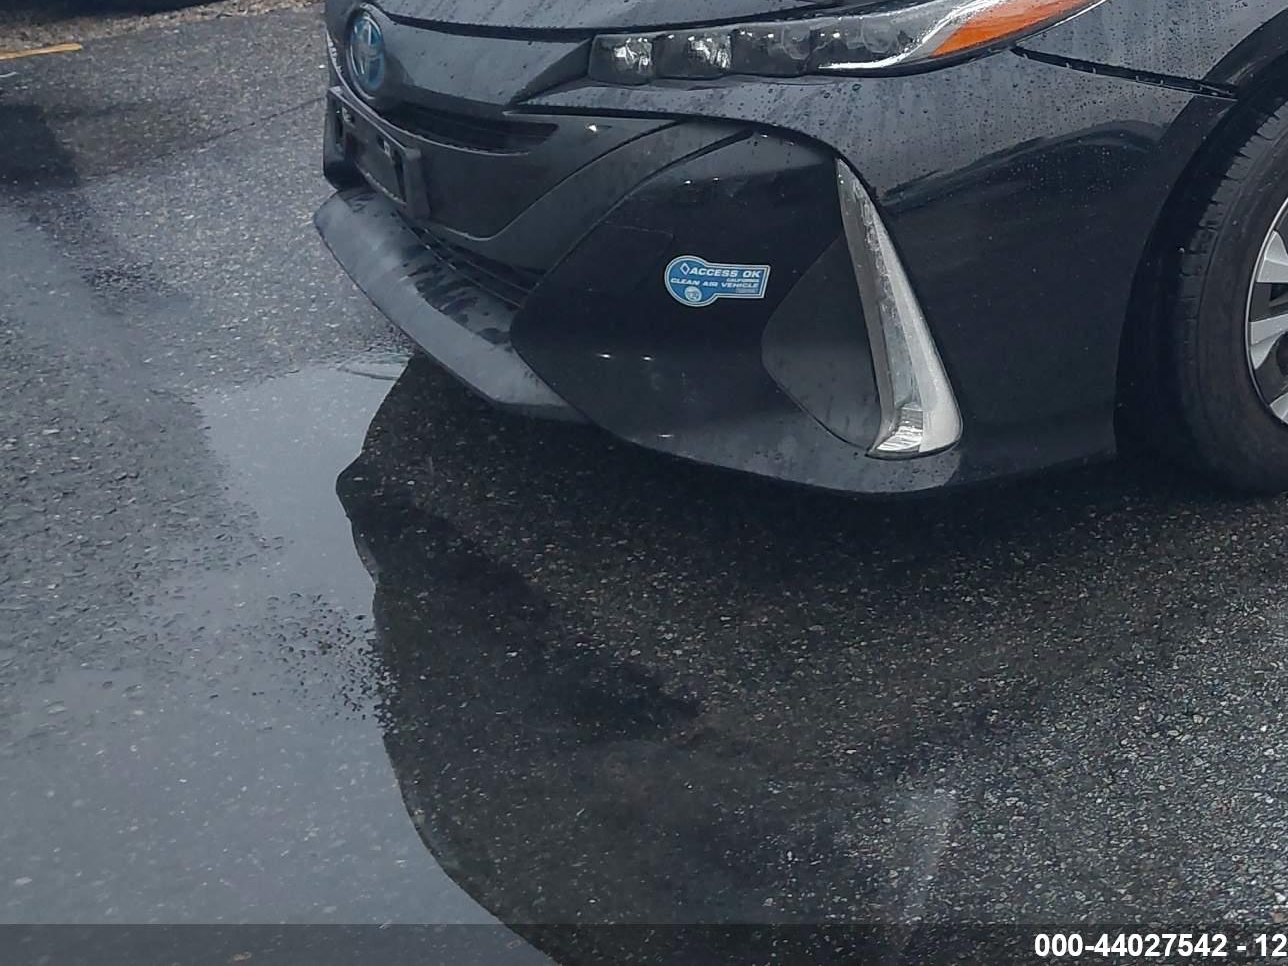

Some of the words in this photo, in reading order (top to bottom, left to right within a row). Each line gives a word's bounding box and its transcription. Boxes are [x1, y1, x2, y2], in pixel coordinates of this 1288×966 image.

[689, 267, 738, 278] ACCESS
[743, 270, 760, 278] OK
[670, 277, 701, 286] CLEAN
